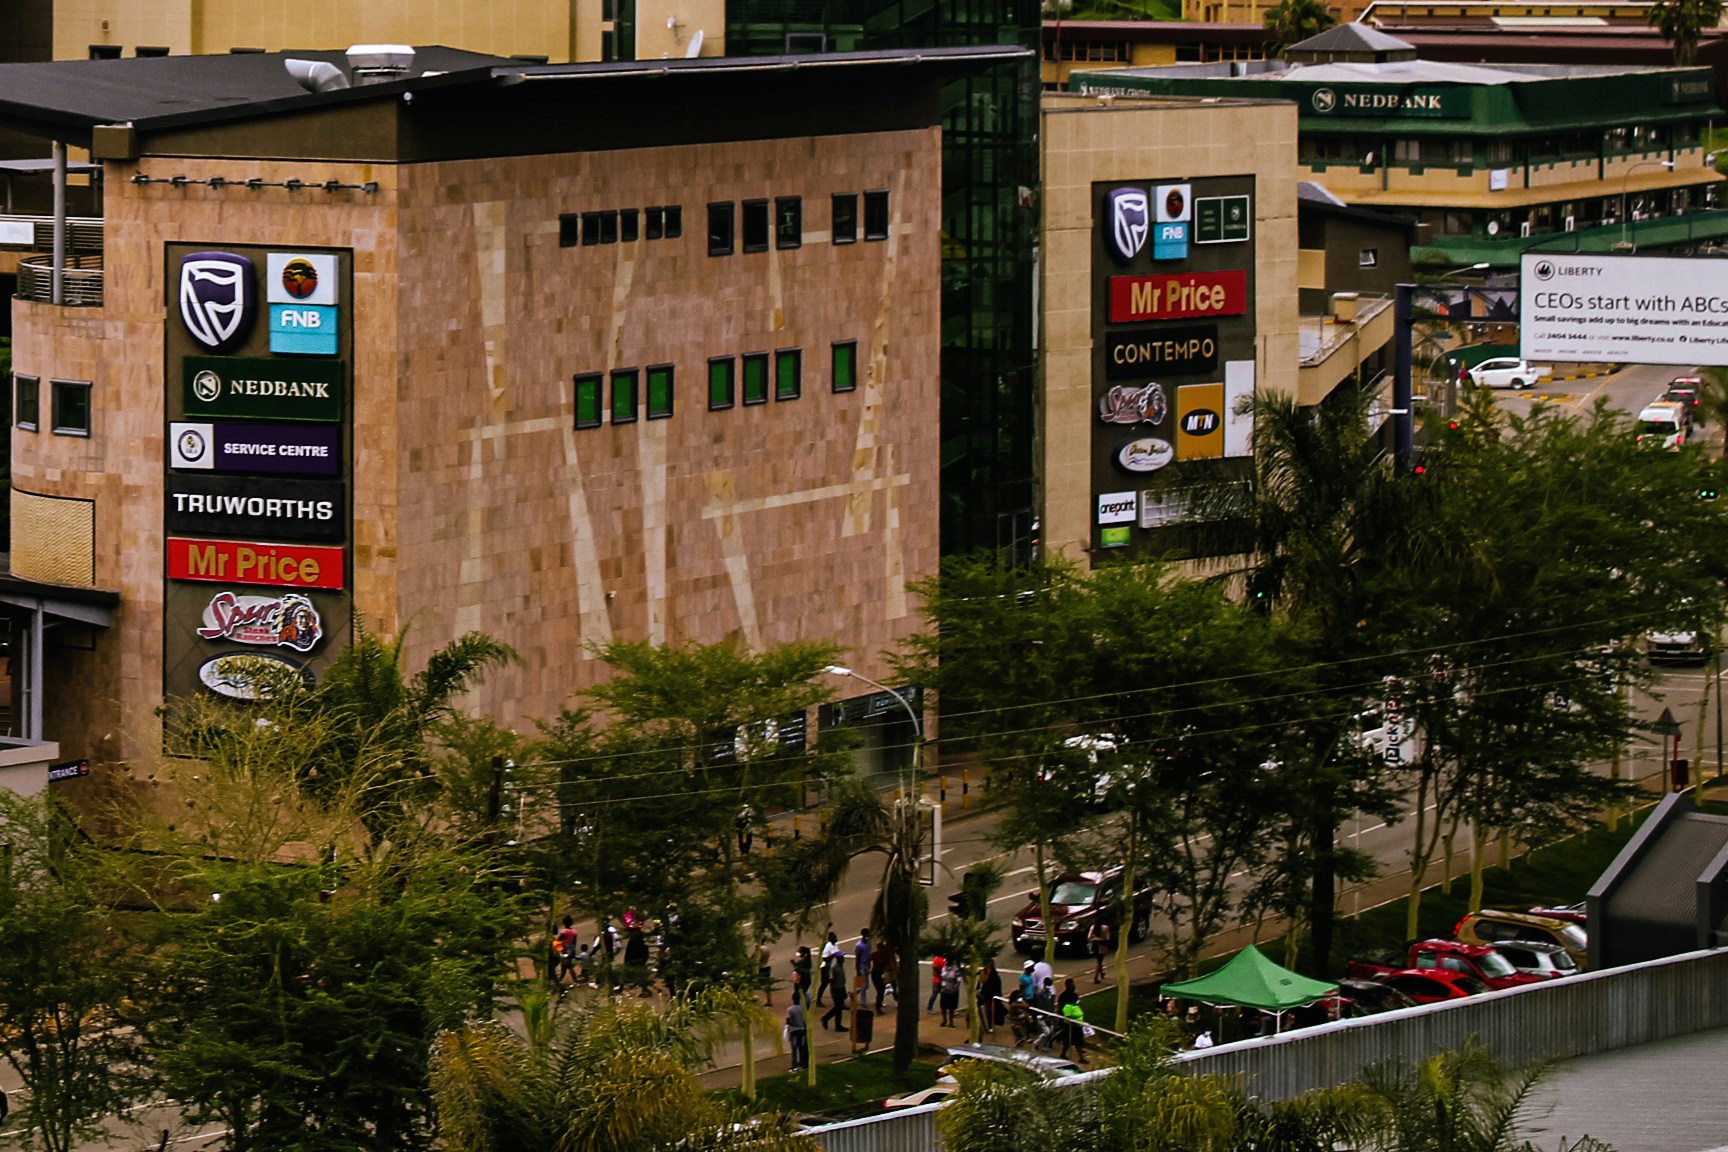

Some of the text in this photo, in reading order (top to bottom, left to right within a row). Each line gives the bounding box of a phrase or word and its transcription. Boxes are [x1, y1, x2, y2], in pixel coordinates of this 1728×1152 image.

[1344, 94, 1442, 109] NEDBANK
[1162, 226, 1185, 240] FNB
[1558, 266, 1603, 276] LIBERTY
[1130, 279, 1226, 315] Mr Price
[1534, 292, 1728, 314] CEOs start with ABCs
[280, 310, 322, 329] FNB
[1557, 316, 1587, 324] savings
[1626, 317, 1639, 326] big
[1114, 338, 1214, 364] CONTEMPO
[230, 380, 330, 398] NEDBANK
[1187, 414, 1214, 431] MTN
[224, 443, 329, 457] SERVICE CENTRE
[174, 493, 333, 520] TRUWORTHS
[188, 545, 320, 582] Mr Price
[198, 593, 281, 638] Spur
